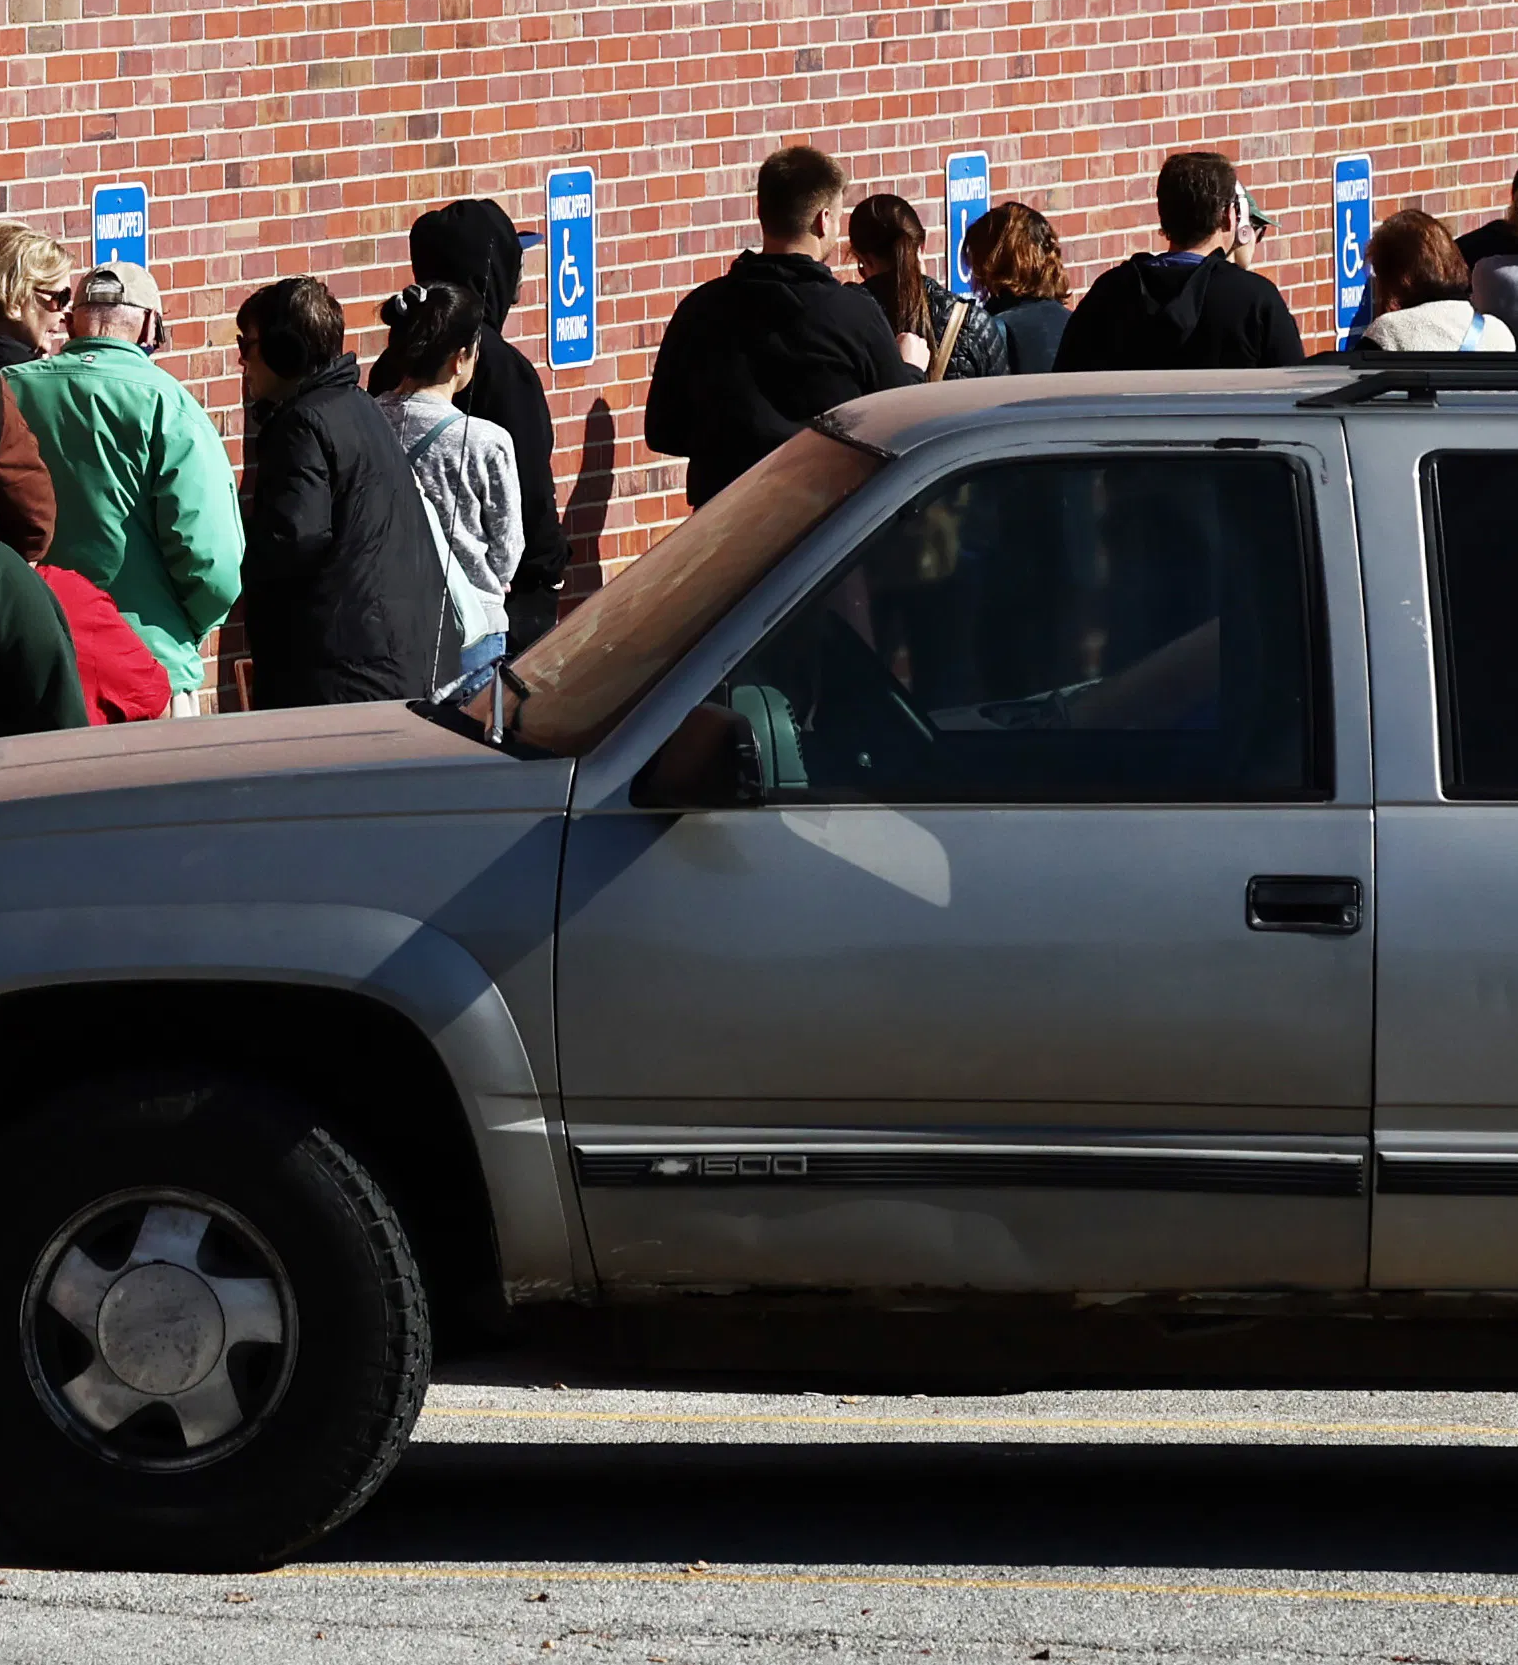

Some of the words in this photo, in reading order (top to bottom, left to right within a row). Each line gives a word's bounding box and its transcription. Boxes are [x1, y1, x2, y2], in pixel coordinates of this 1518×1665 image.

[950, 175, 986, 203] HANDICAPPED
[1336, 178, 1369, 203] HANDICAPPED
[550, 193, 592, 221] HANDICAPPED
[97, 211, 144, 241] HANDICAPPED
[556, 314, 587, 342] PARKING
[697, 1154, 807, 1176] 1500
